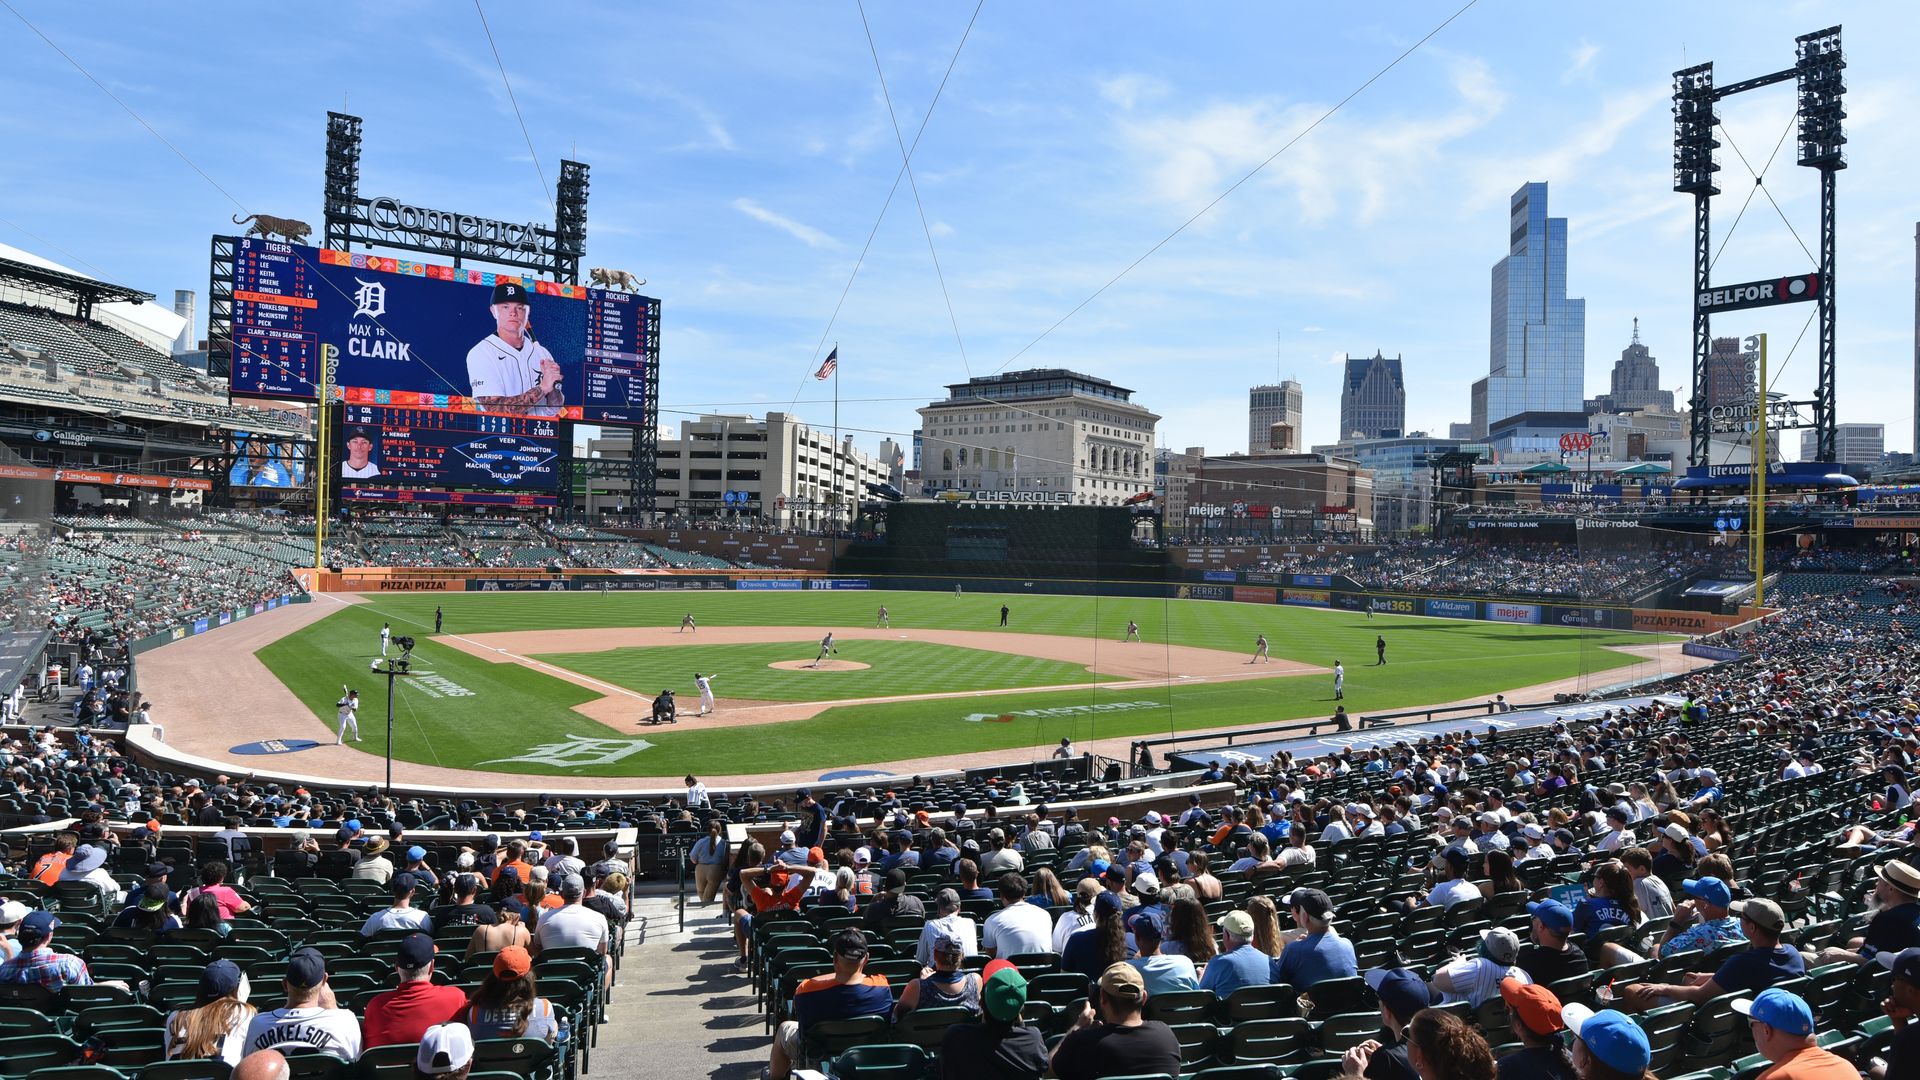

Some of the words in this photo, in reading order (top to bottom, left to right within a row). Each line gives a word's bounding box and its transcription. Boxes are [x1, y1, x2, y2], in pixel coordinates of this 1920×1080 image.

[265, 243, 291, 253] TIGERS
[419, 233, 500, 256] PARK
[260, 254, 289, 263] McGONIGLE
[606, 292, 629, 301] ROCKIES
[1700, 284, 1773, 306] BELFOR
[258, 312, 287, 320] McKINSTRY
[348, 323, 371, 337] MAX
[376, 328, 385, 336] 15
[348, 338, 411, 361] CLARK
[481, 424, 485, 432] 8
[53, 430, 94, 442] Gallagher
[1564, 433, 1589, 451] AAA
[1708, 466, 1728, 478] Lite
[82, 474, 100, 482] Caesars
[1572, 482, 1592, 494] Lite
[280, 492, 308, 500] MARKET
[976, 490, 1076, 502] CHEVROLET
[1189, 504, 1226, 518] meijer
[381, 581, 412, 590] PIZZA!
[416, 581, 446, 590] PIZZA!
[812, 581, 832, 589] DTE
[1192, 586, 1224, 596] FERRIS
[1372, 599, 1412, 612] bet365
[1440, 602, 1470, 611] McLaren
[1497, 608, 1529, 619] meijer
[1562, 614, 1588, 624] Corona
[1634, 615, 1667, 626] PIZZA!
[1670, 617, 1706, 628] PIZZA!
